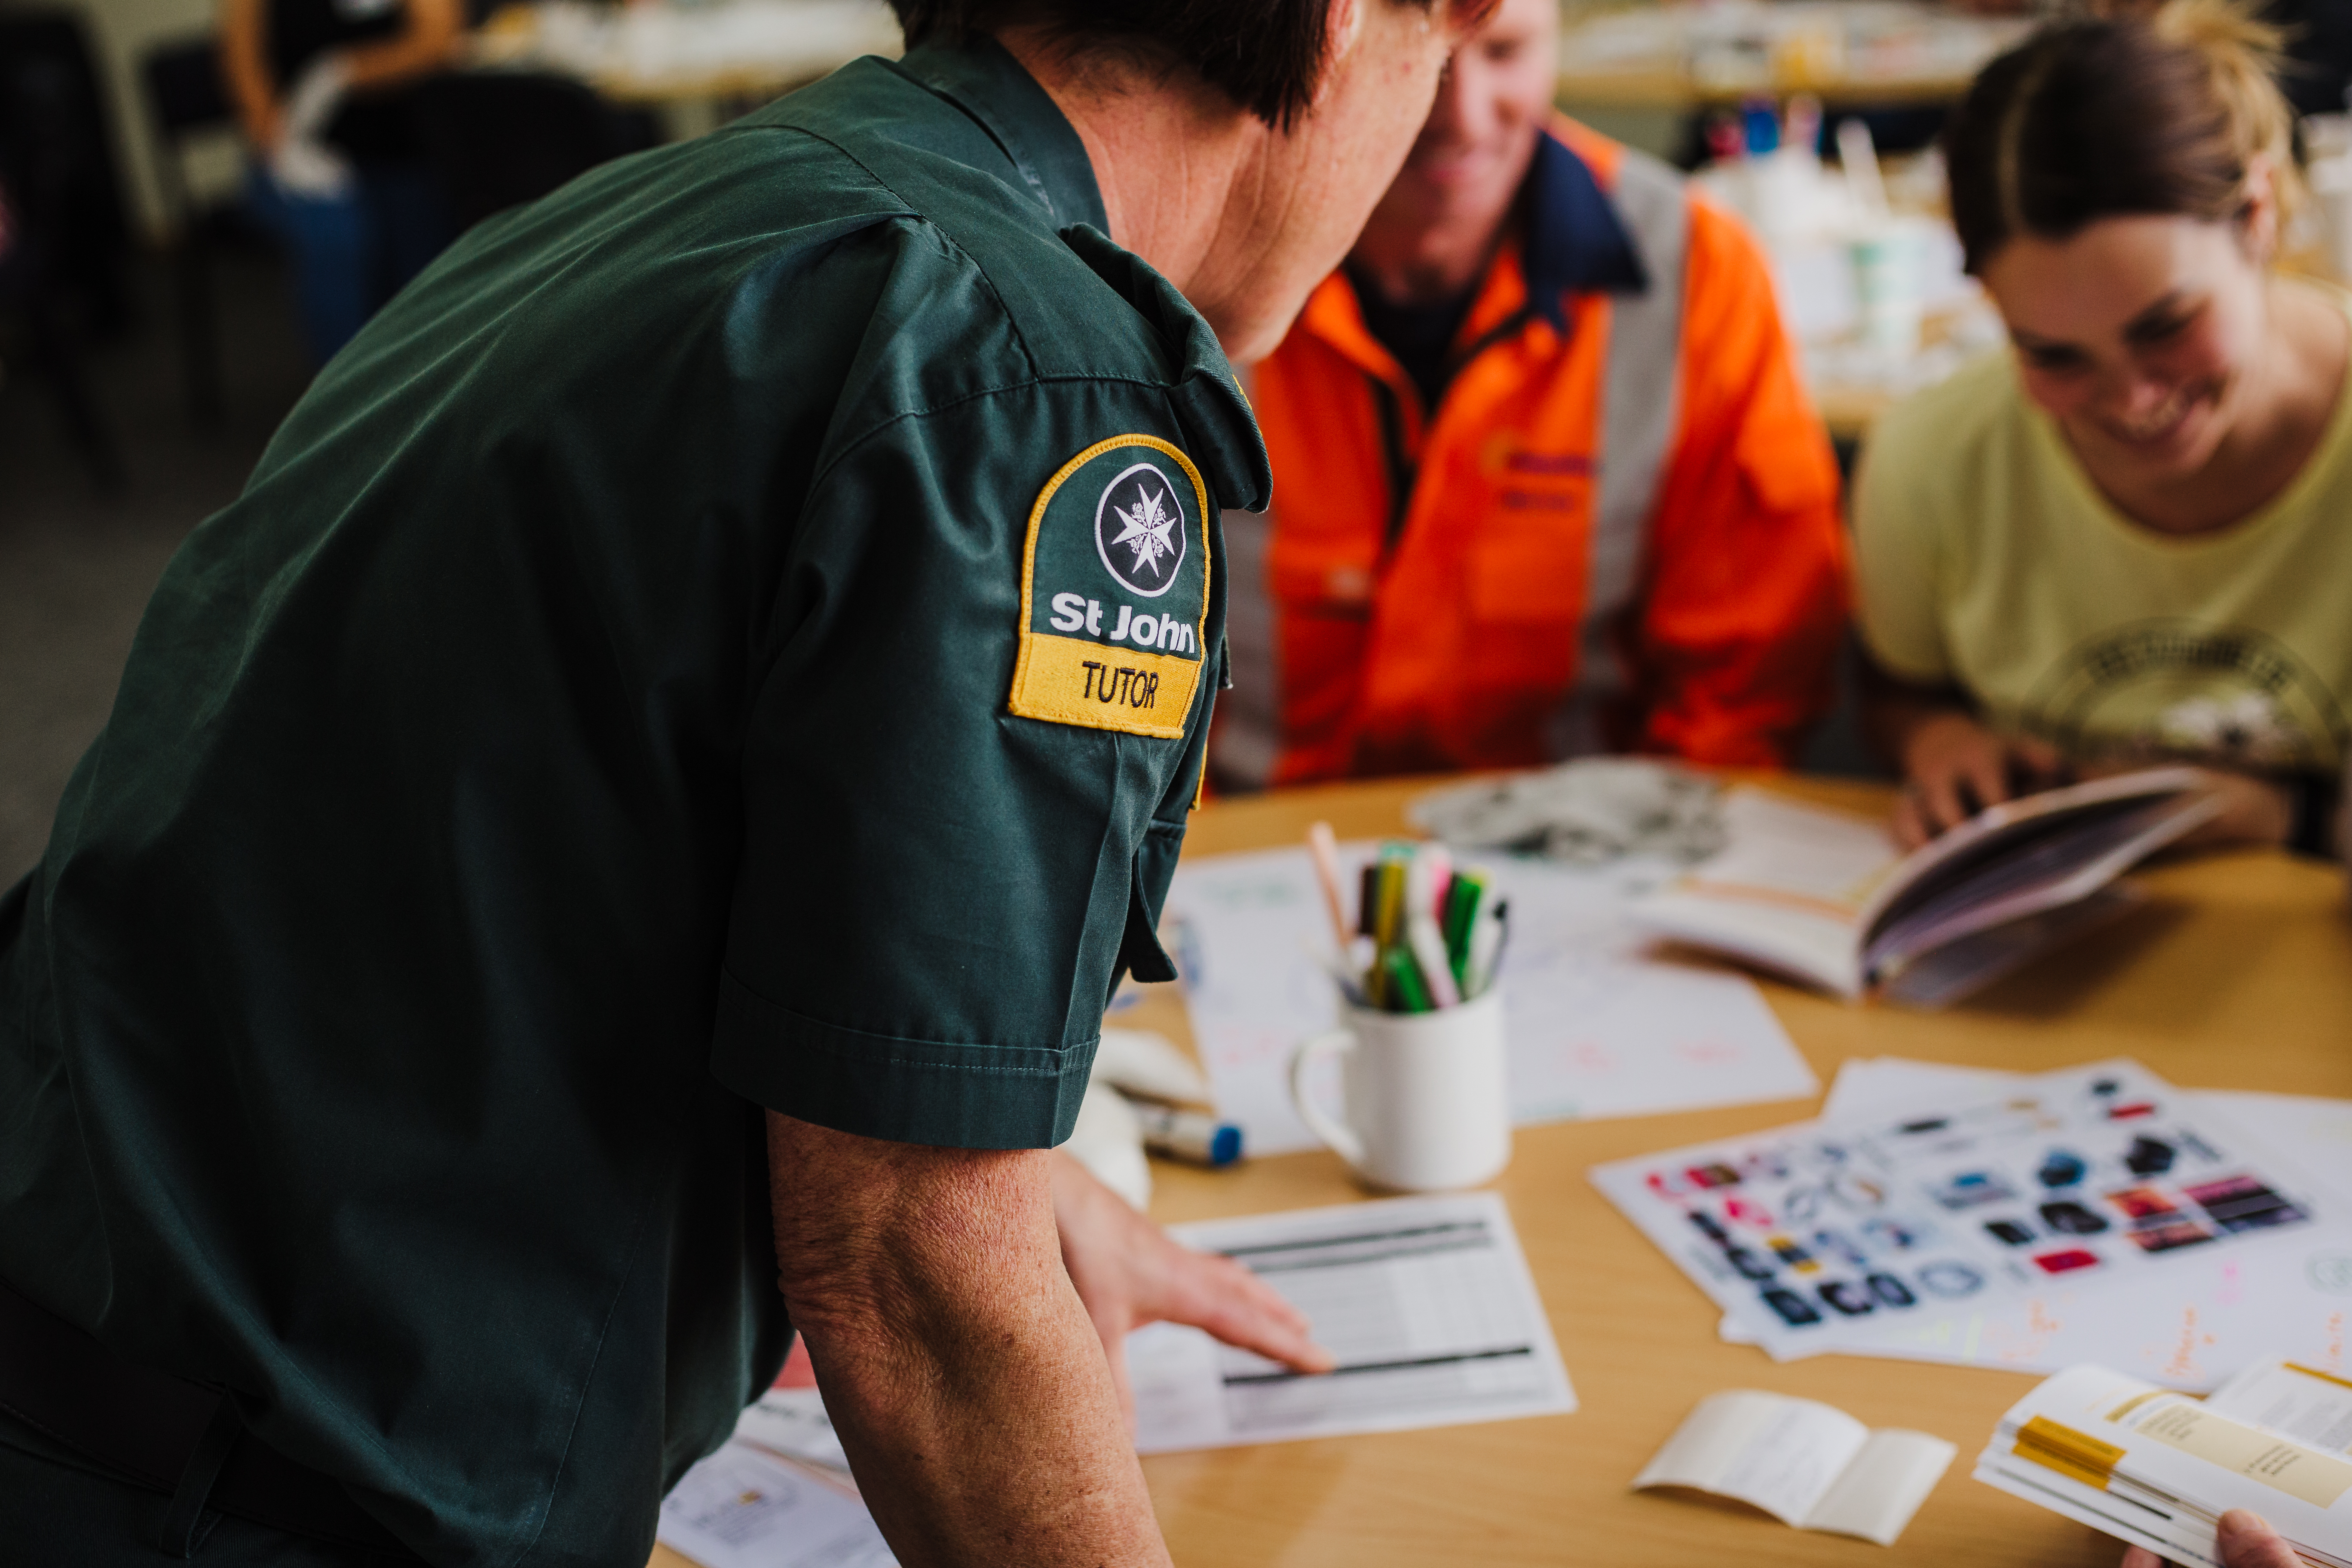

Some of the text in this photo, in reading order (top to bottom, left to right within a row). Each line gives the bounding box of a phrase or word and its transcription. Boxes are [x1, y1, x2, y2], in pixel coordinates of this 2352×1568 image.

[1050, 592, 1194, 653] St John
[1082, 661, 1159, 709] TUTOR
